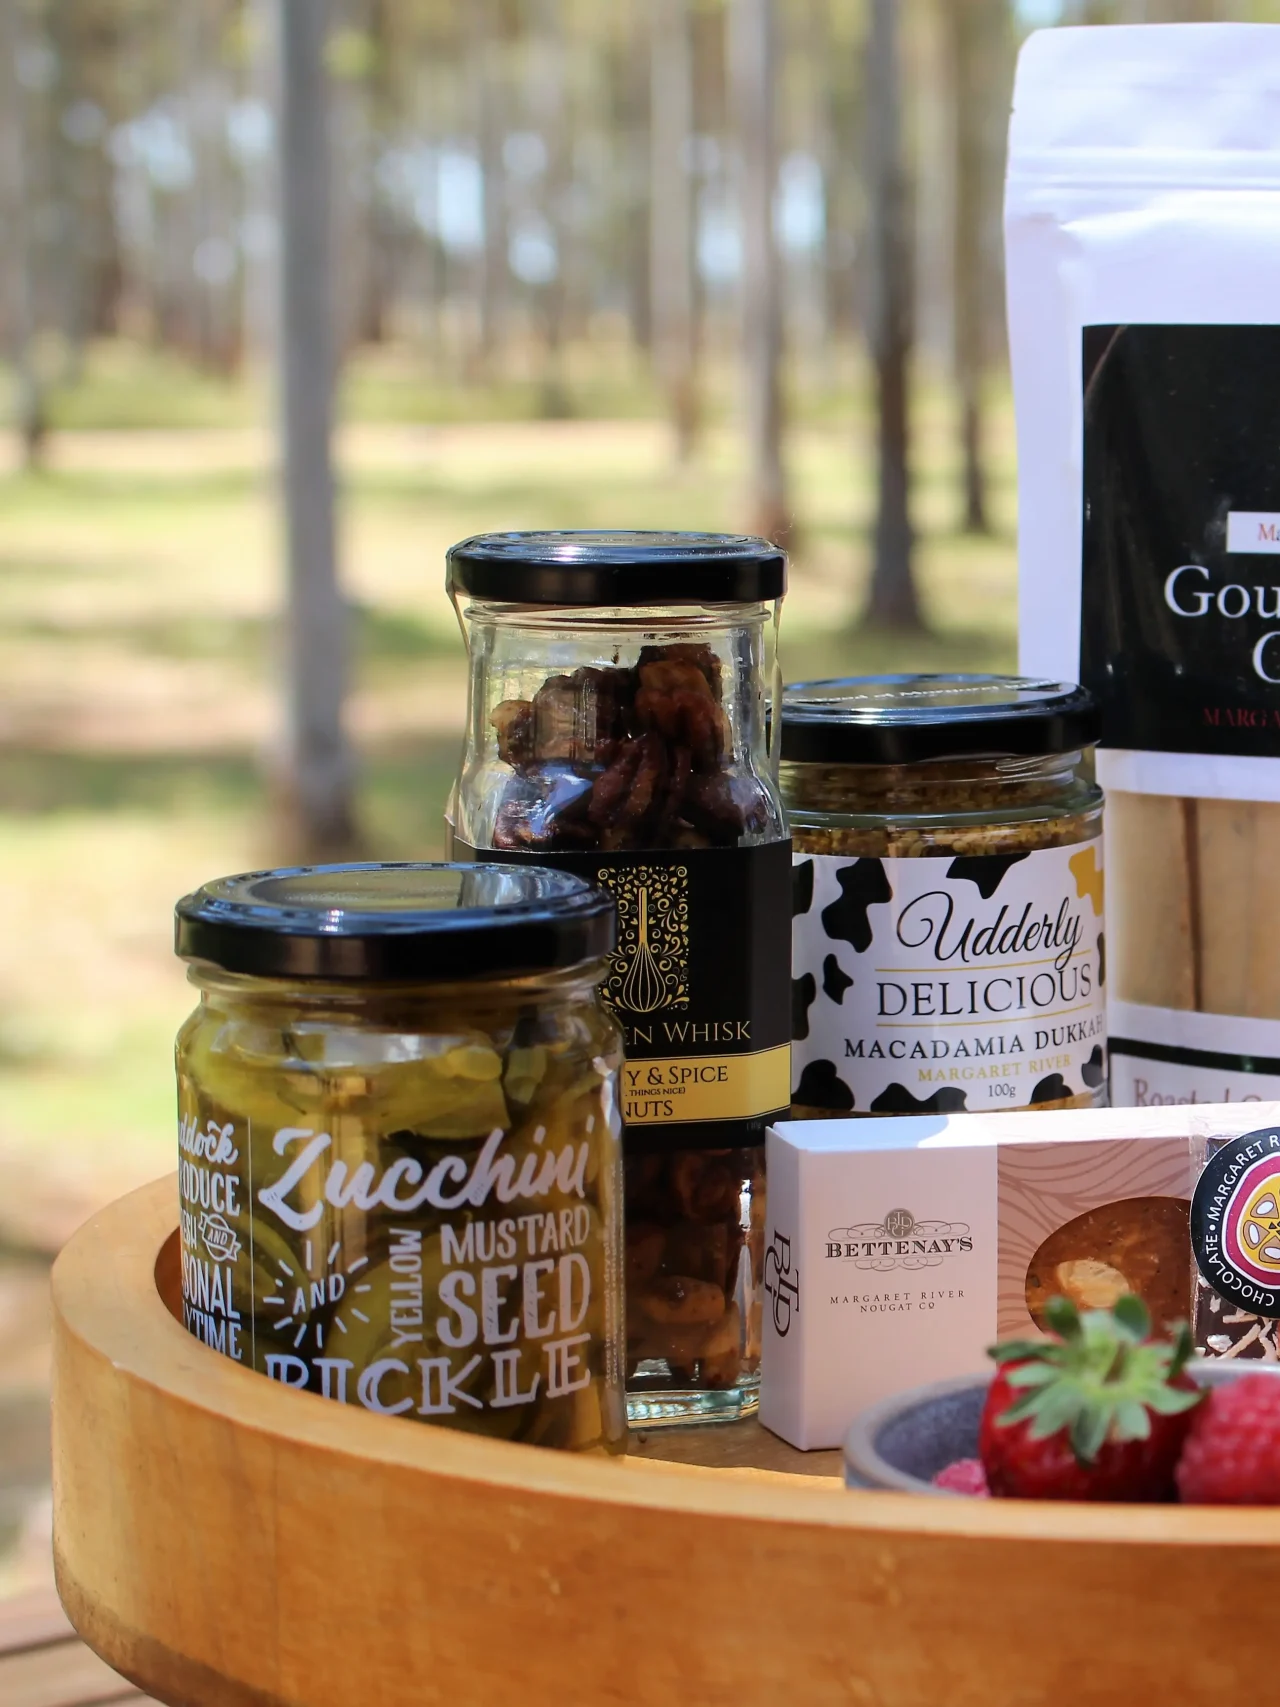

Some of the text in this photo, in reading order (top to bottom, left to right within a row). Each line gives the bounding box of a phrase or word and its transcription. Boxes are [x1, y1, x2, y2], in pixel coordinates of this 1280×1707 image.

[896, 890, 1084, 970] Udderly
[876, 963, 1093, 1018] DELICIOUS
[663, 1020, 751, 1043] WHISK
[844, 1013, 1103, 1059] MACADAMIA DUKKAH
[647, 1066, 664, 1086] &
[669, 1065, 729, 1085] SPICE
[917, 1054, 1072, 1082] MARGARET RIVER
[987, 1082, 1016, 1098] 100g
[630, 1086, 686, 1097] THINGS NICE)
[258, 1114, 595, 1232] Zucchini
[1206, 1140, 1265, 1222] MARGARET
[206, 1228, 228, 1246] AND
[440, 1204, 591, 1266] MUSTARD
[824, 1236, 974, 1259] BETTENAY'S
[183, 1250, 241, 1320] SONAL
[388, 1228, 423, 1348] YELLOW
[1205, 1233, 1275, 1307] CHOCOLATE
[293, 1273, 346, 1315] AND
[436, 1252, 592, 1348] SEED
[830, 1290, 965, 1304] MARGARET RIVER
[860, 1303, 912, 1313] NOUGAT
[264, 1332, 592, 1416] PICKLE
